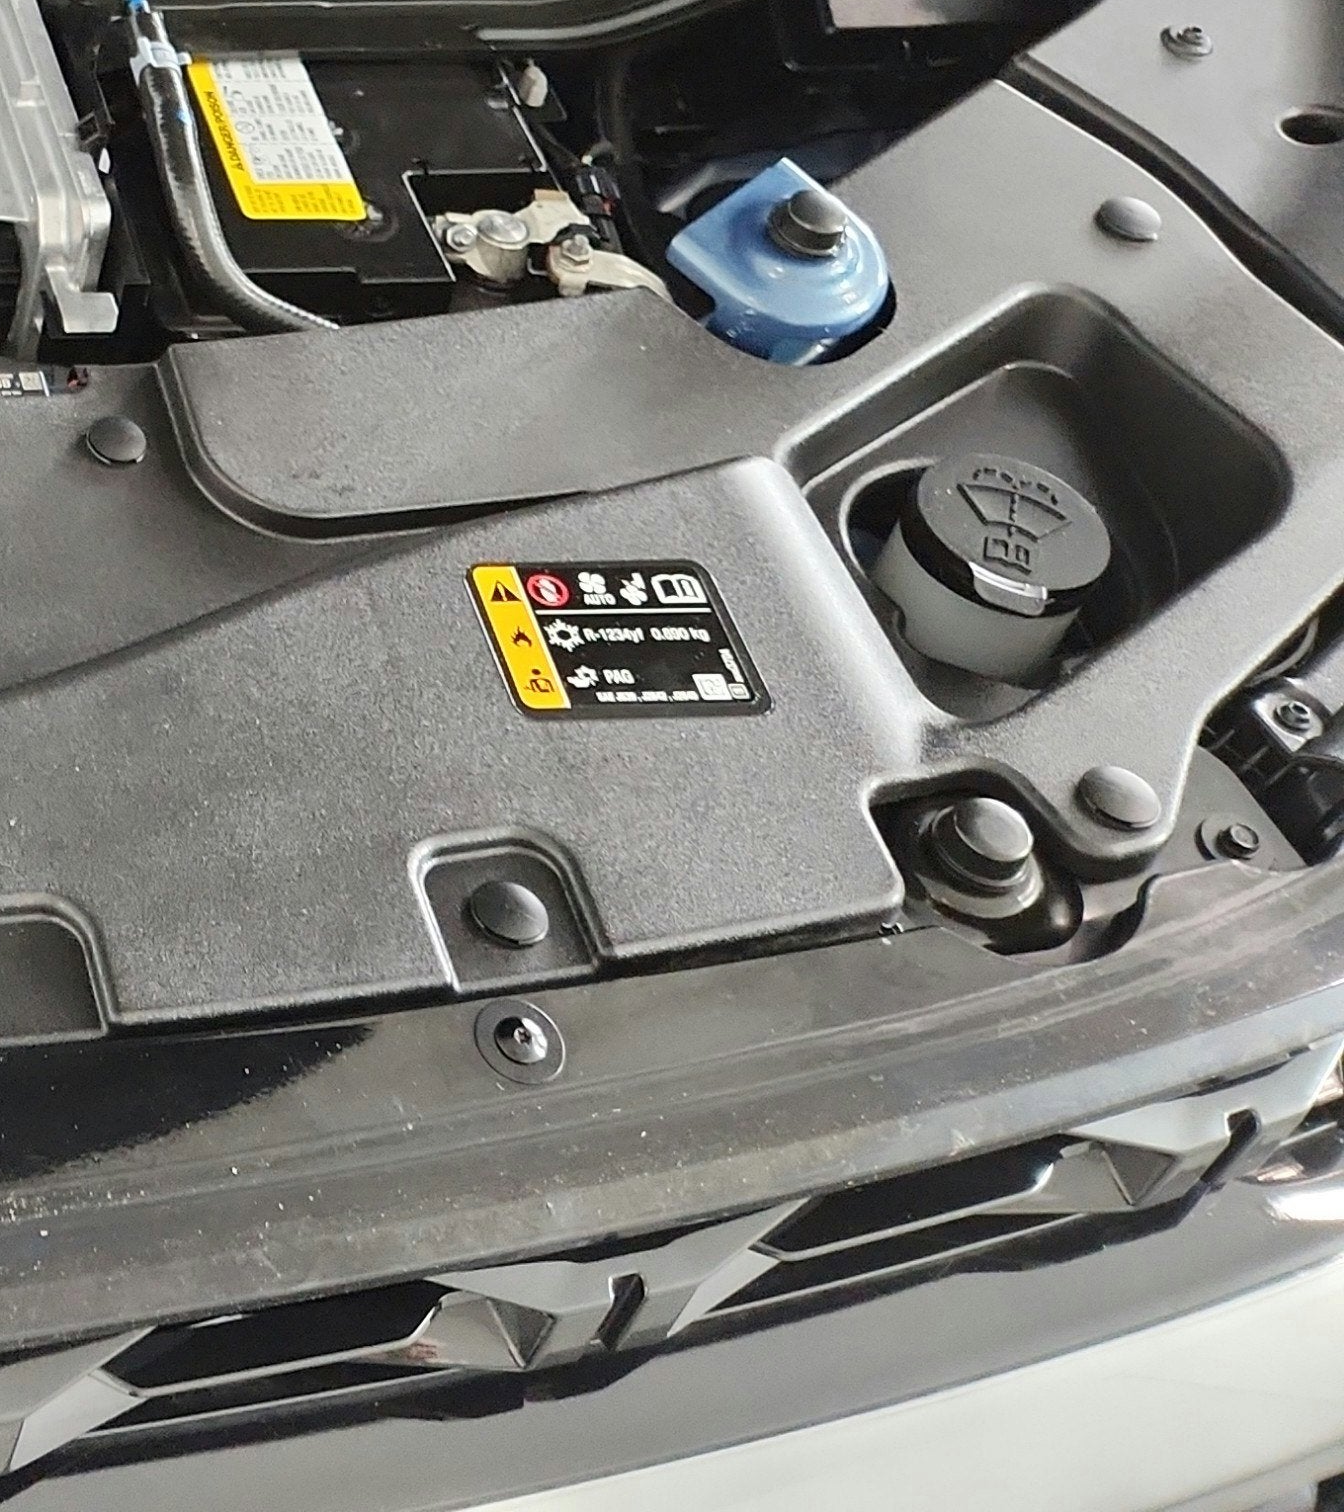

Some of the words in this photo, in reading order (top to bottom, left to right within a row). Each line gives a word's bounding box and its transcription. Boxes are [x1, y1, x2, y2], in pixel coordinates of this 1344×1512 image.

[203, 91, 224, 123] POISON
[219, 124, 241, 163] DANGER
[583, 593, 616, 606] AUTO
[602, 669, 635, 684] PAG
